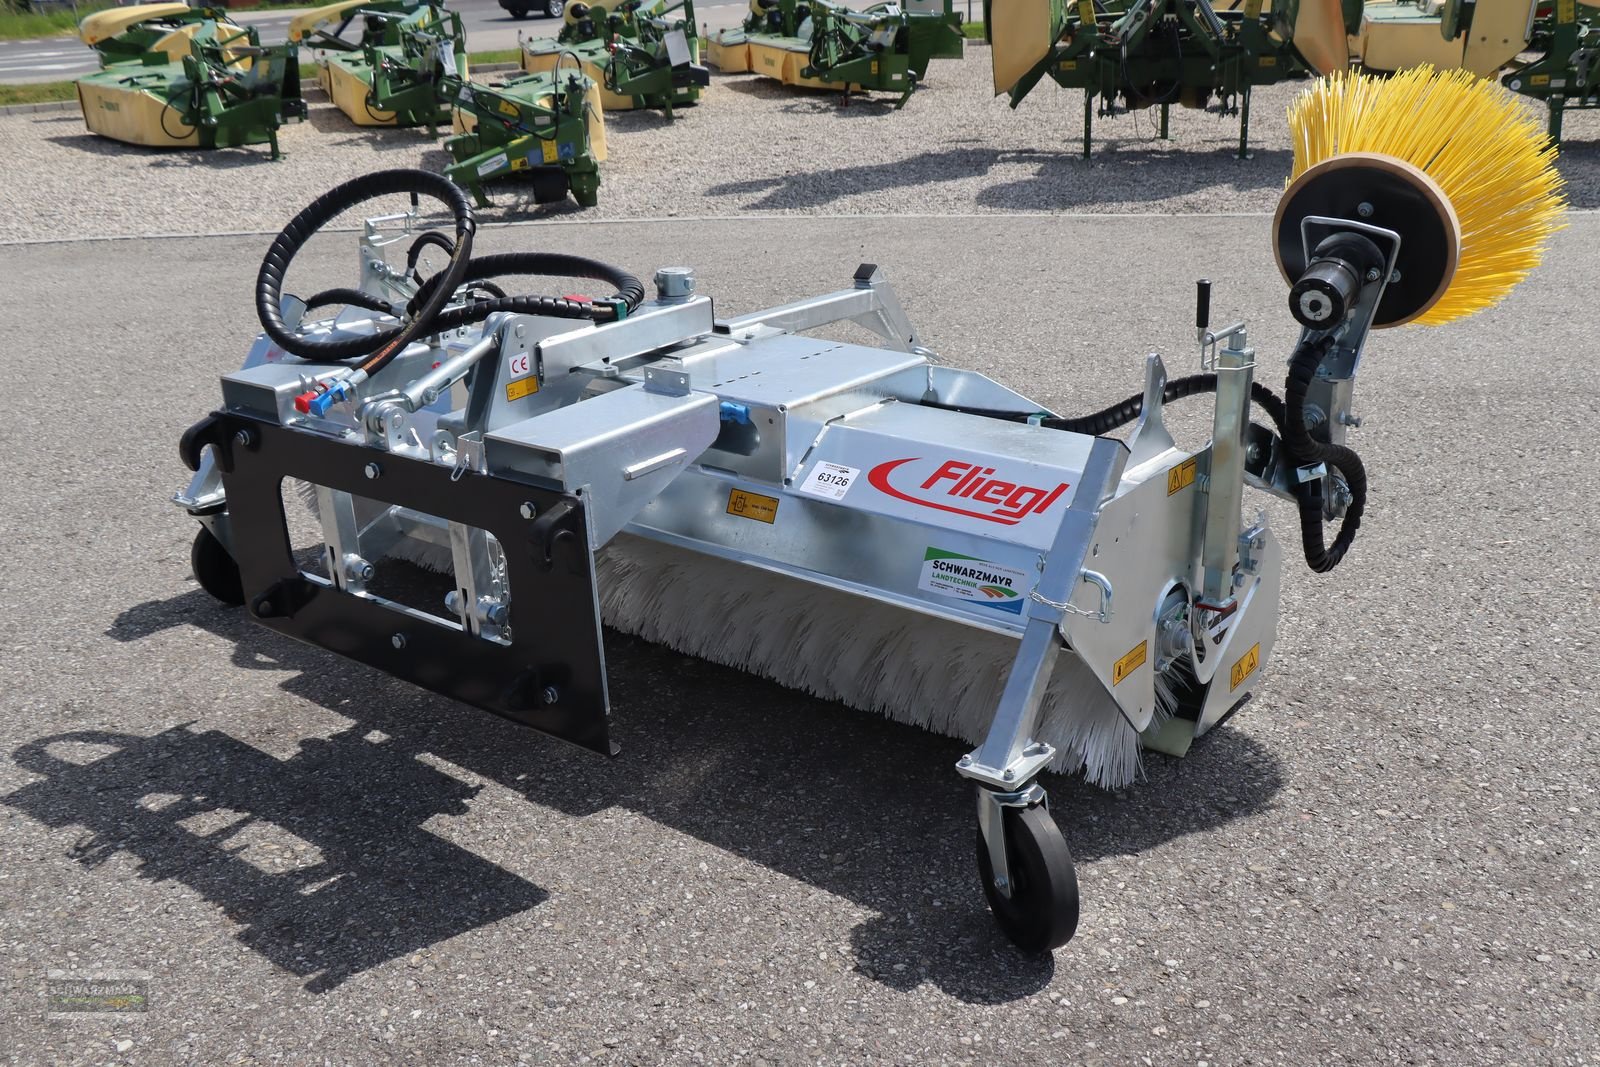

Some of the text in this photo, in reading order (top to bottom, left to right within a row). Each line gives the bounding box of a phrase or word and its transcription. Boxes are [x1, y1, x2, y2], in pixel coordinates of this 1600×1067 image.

[817, 472, 849, 487] 63126
[920, 460, 1070, 519] Fliegl
[931, 572, 978, 588] LANDTECHNIK
[932, 560, 1013, 587] SCHWARZMAYR
